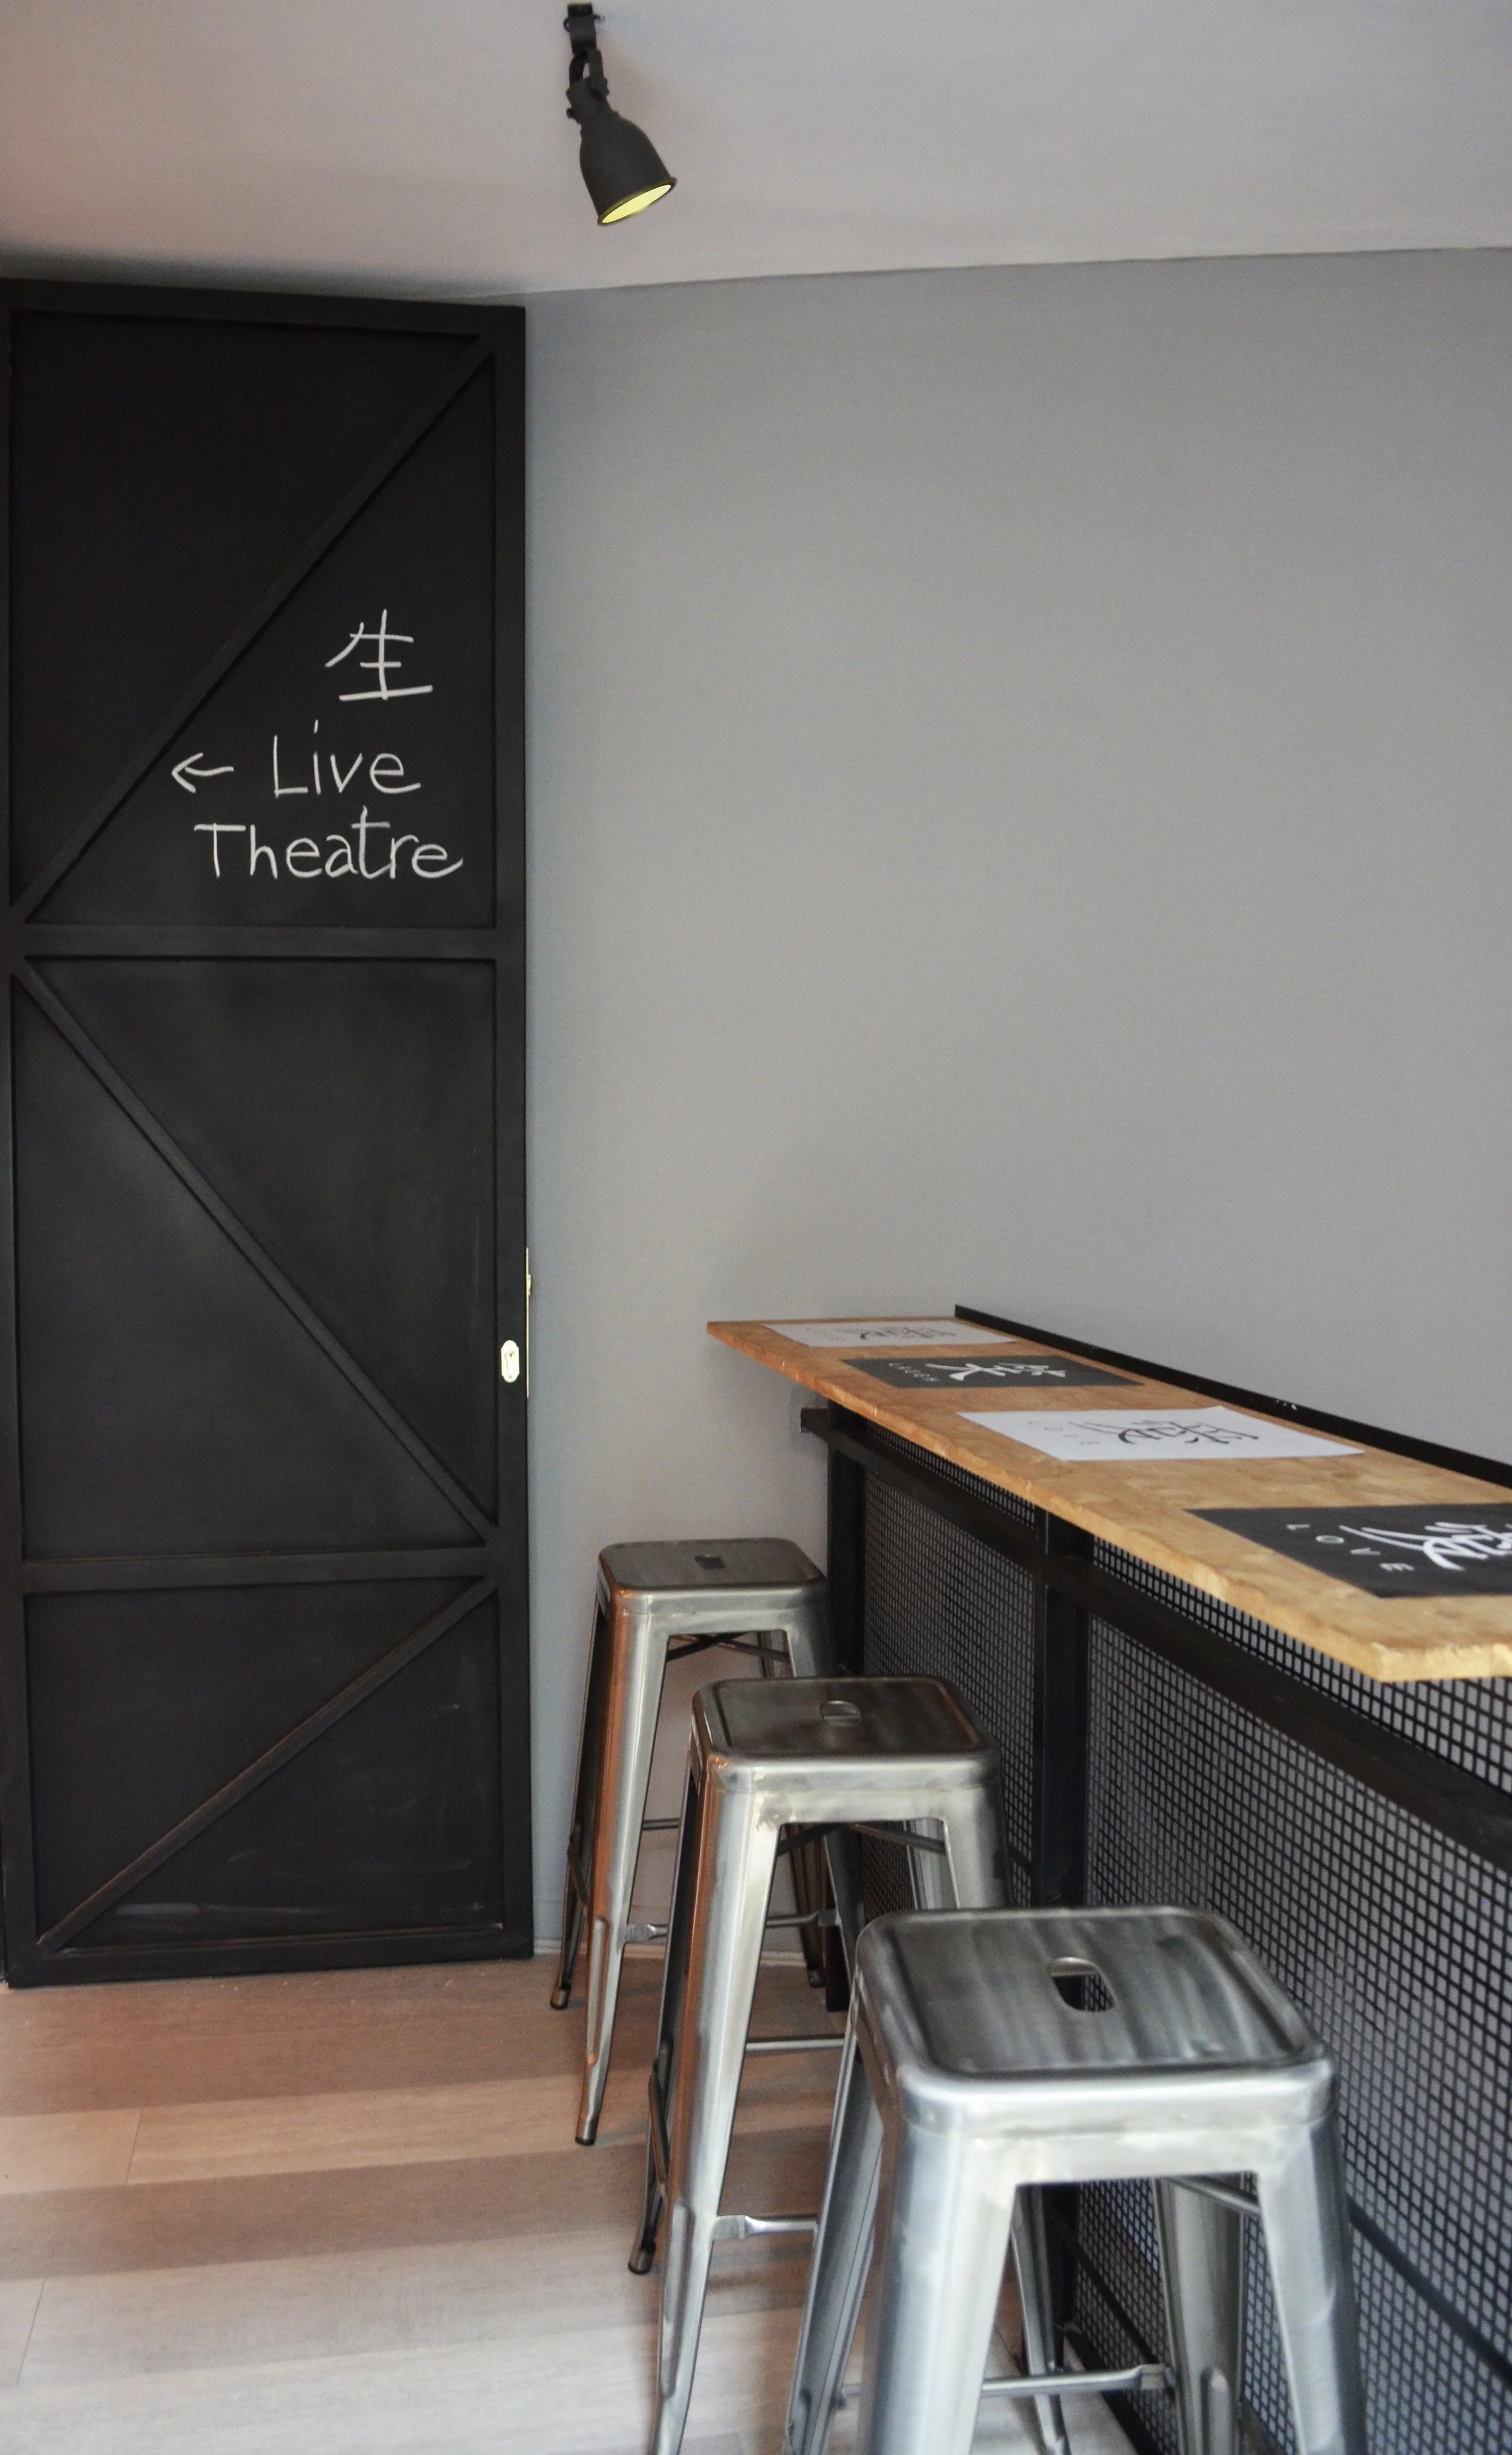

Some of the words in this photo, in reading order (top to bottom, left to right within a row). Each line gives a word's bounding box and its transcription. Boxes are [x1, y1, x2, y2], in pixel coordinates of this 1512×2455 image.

[324, 608, 433, 701] 生
[273, 719, 422, 799] Live
[194, 805, 463, 879] Theatre
[1286, 1524, 1415, 1572] LOVE
